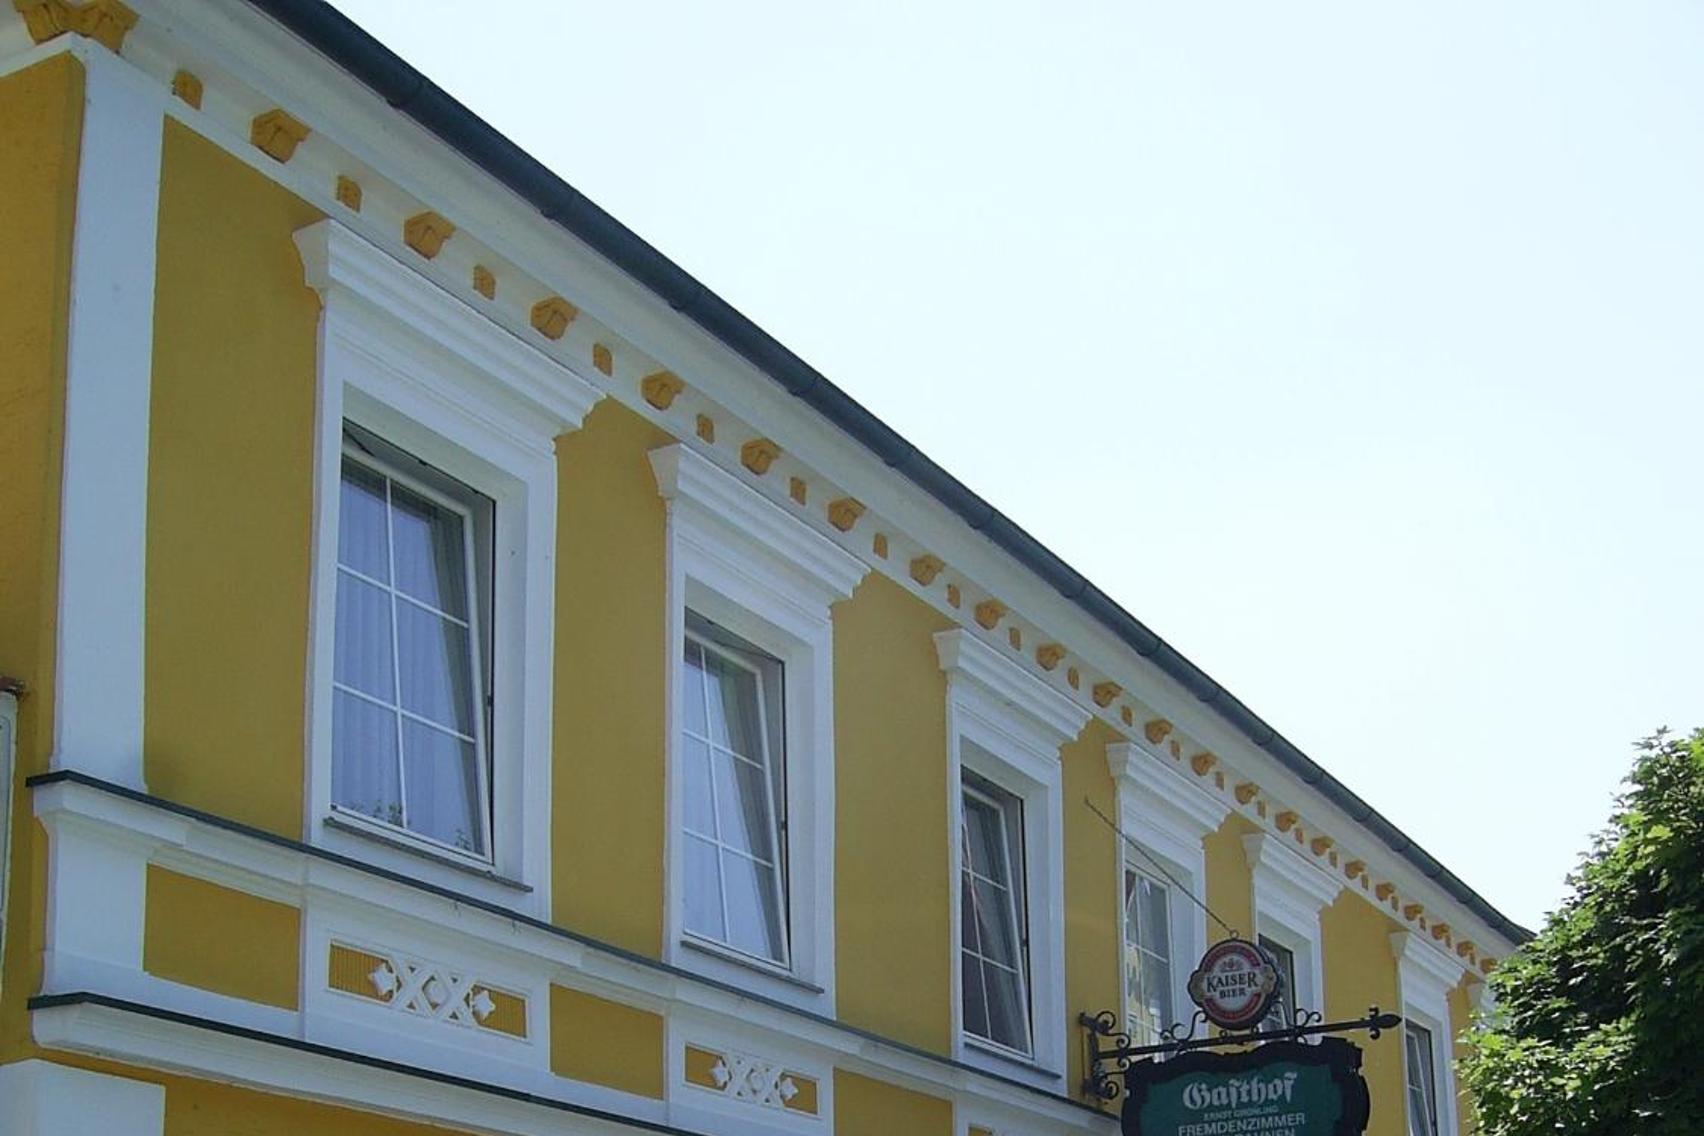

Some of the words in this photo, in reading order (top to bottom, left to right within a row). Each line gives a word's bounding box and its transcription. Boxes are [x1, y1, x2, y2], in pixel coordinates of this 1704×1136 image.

[1207, 973, 1258, 992] KAISER
[1220, 988, 1247, 999] BIER
[1183, 1072, 1297, 1110] Gasthof
